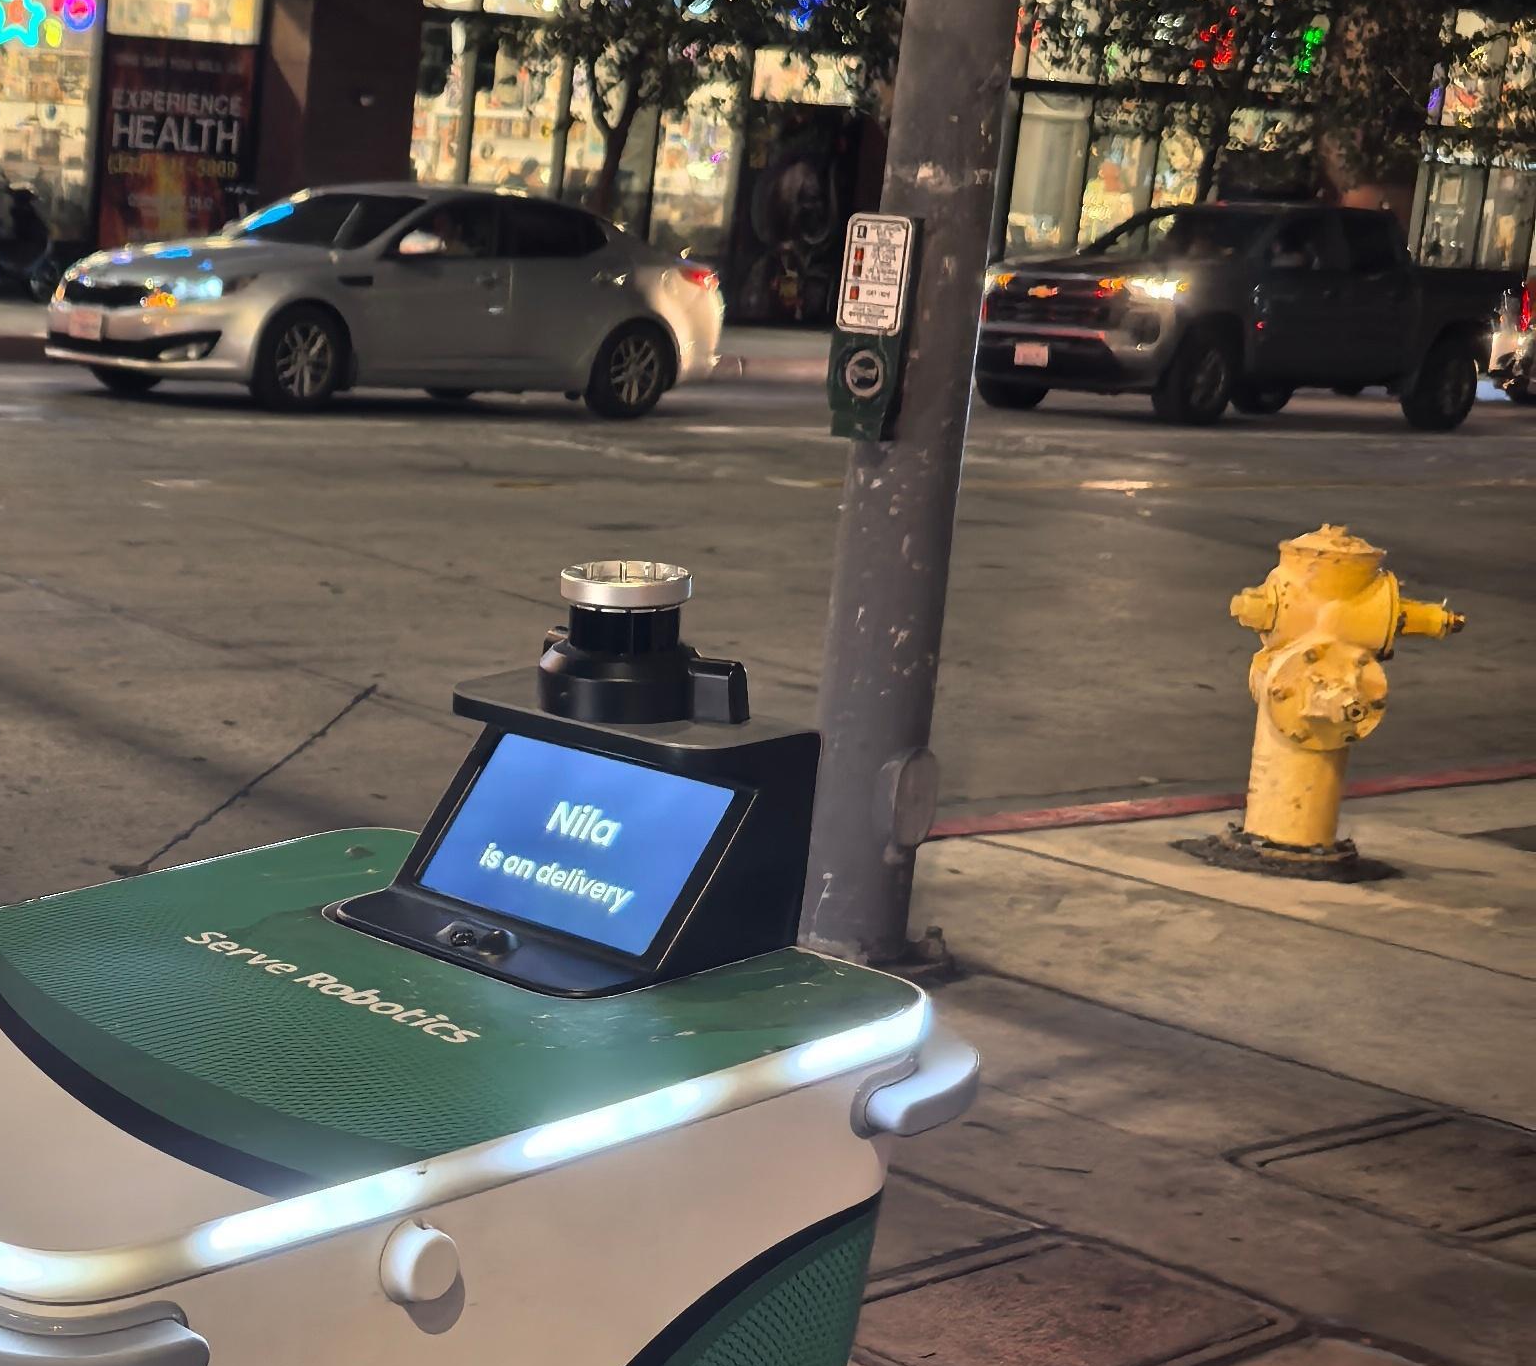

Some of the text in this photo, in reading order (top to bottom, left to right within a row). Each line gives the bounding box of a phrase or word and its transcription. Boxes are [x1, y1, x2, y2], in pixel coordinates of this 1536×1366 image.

[111, 88, 244, 118] EXPERIENCE
[111, 112, 241, 155] HEALTH
[545, 800, 622, 848] Nila
[479, 842, 635, 915] is on delivery
[184, 931, 481, 1044] Serve Robotics
